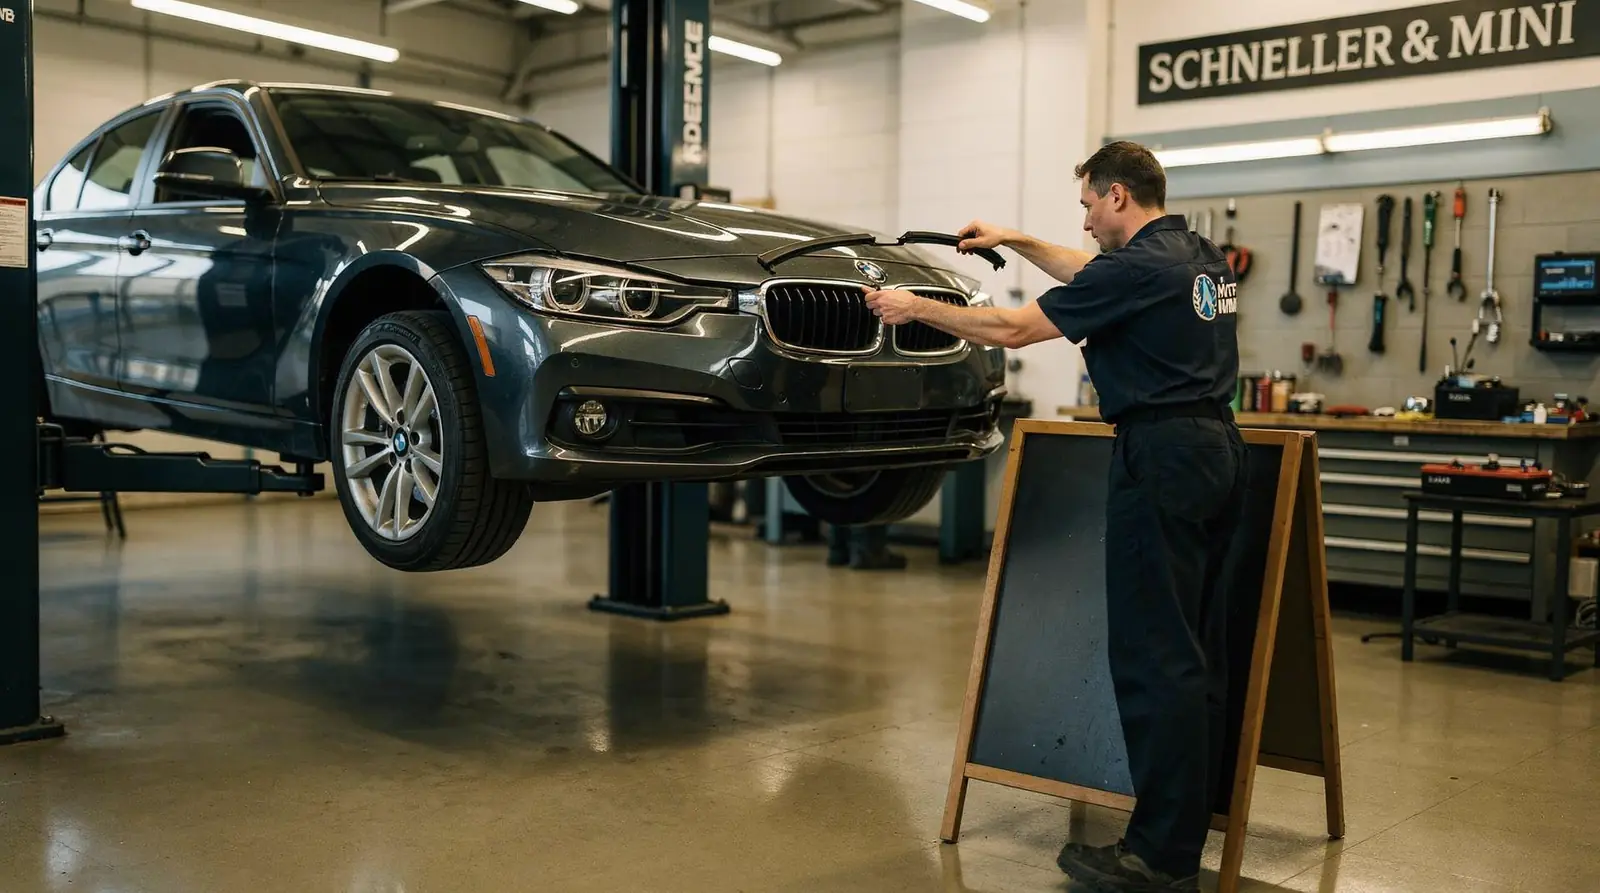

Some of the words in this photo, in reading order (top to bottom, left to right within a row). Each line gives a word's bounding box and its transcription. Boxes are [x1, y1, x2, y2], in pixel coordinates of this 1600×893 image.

[1148, 24, 1395, 93] SCHNELLER
[1402, 19, 1439, 64] &
[1448, 0, 1577, 59] MINI
